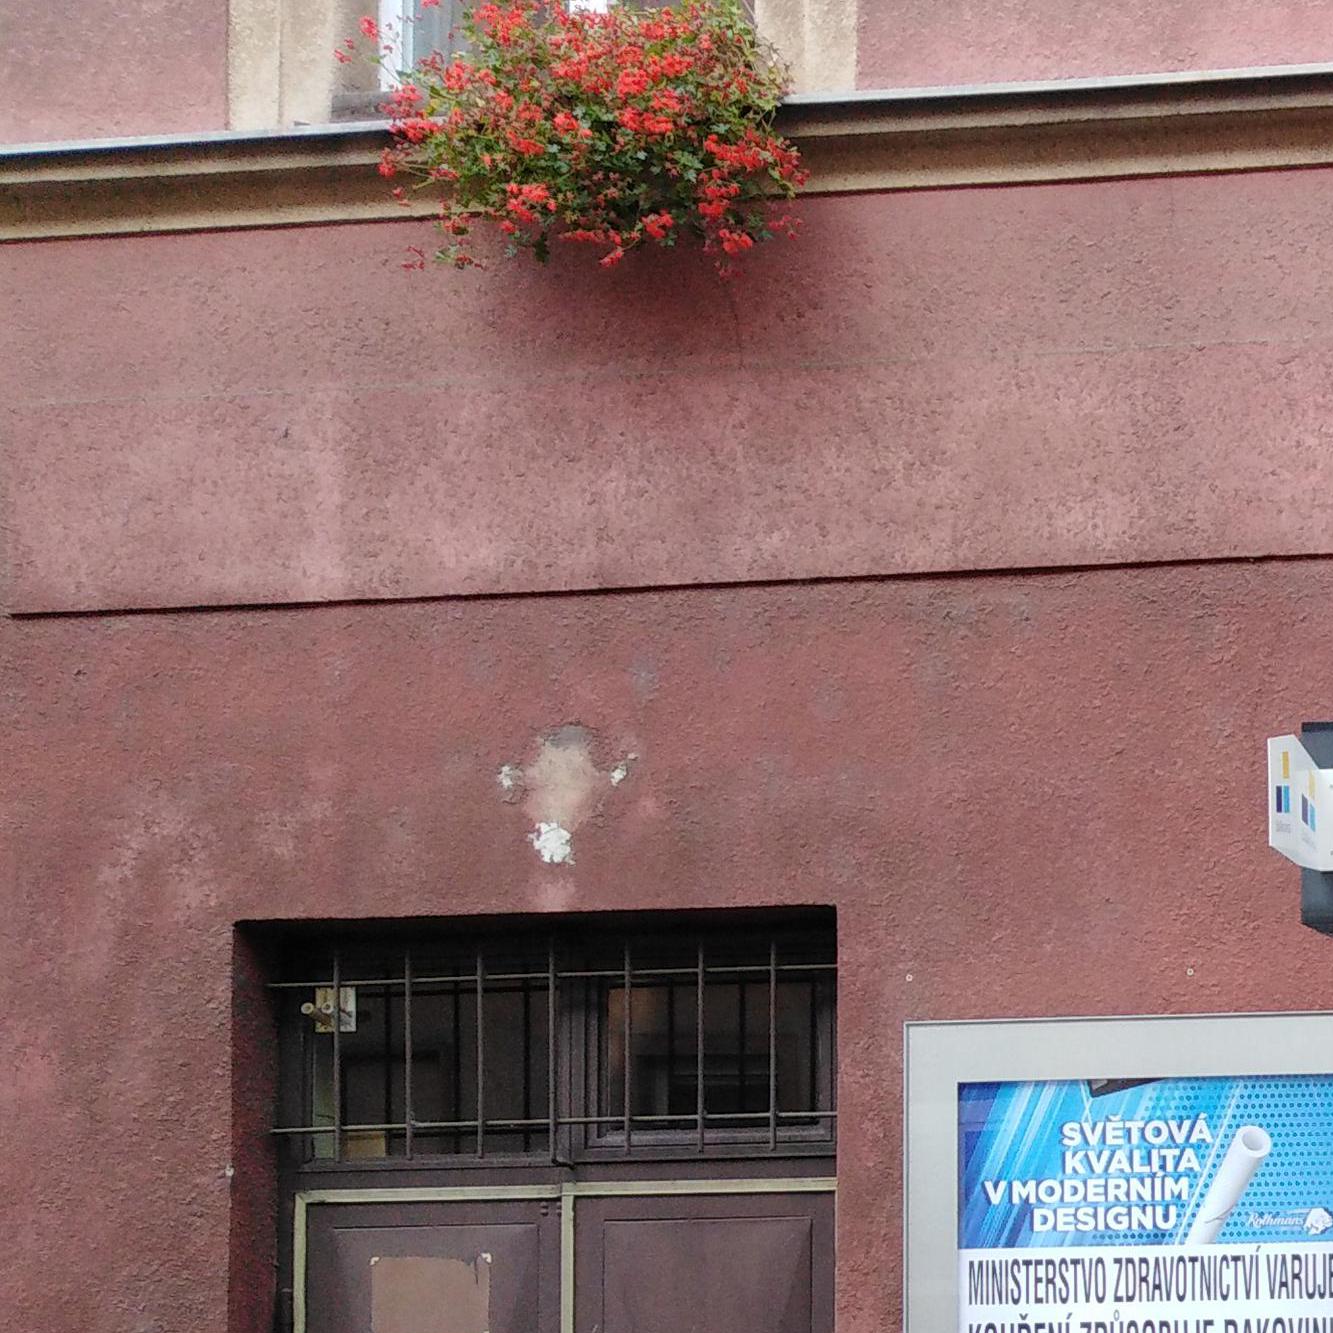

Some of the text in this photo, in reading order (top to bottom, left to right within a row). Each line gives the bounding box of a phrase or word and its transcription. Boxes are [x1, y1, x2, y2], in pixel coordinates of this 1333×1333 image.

[1061, 1113, 1213, 1147] SVĚTOVÁ
[1065, 1147, 1200, 1174] KVALITA
[985, 1172, 1189, 1205] V MODERNÍM
[1033, 1205, 1177, 1232] DESIGNU
[969, 1257, 1106, 1305] MINISTERSTVO
[1113, 1246, 1261, 1303] ZDRAVOTNICTVÍ
